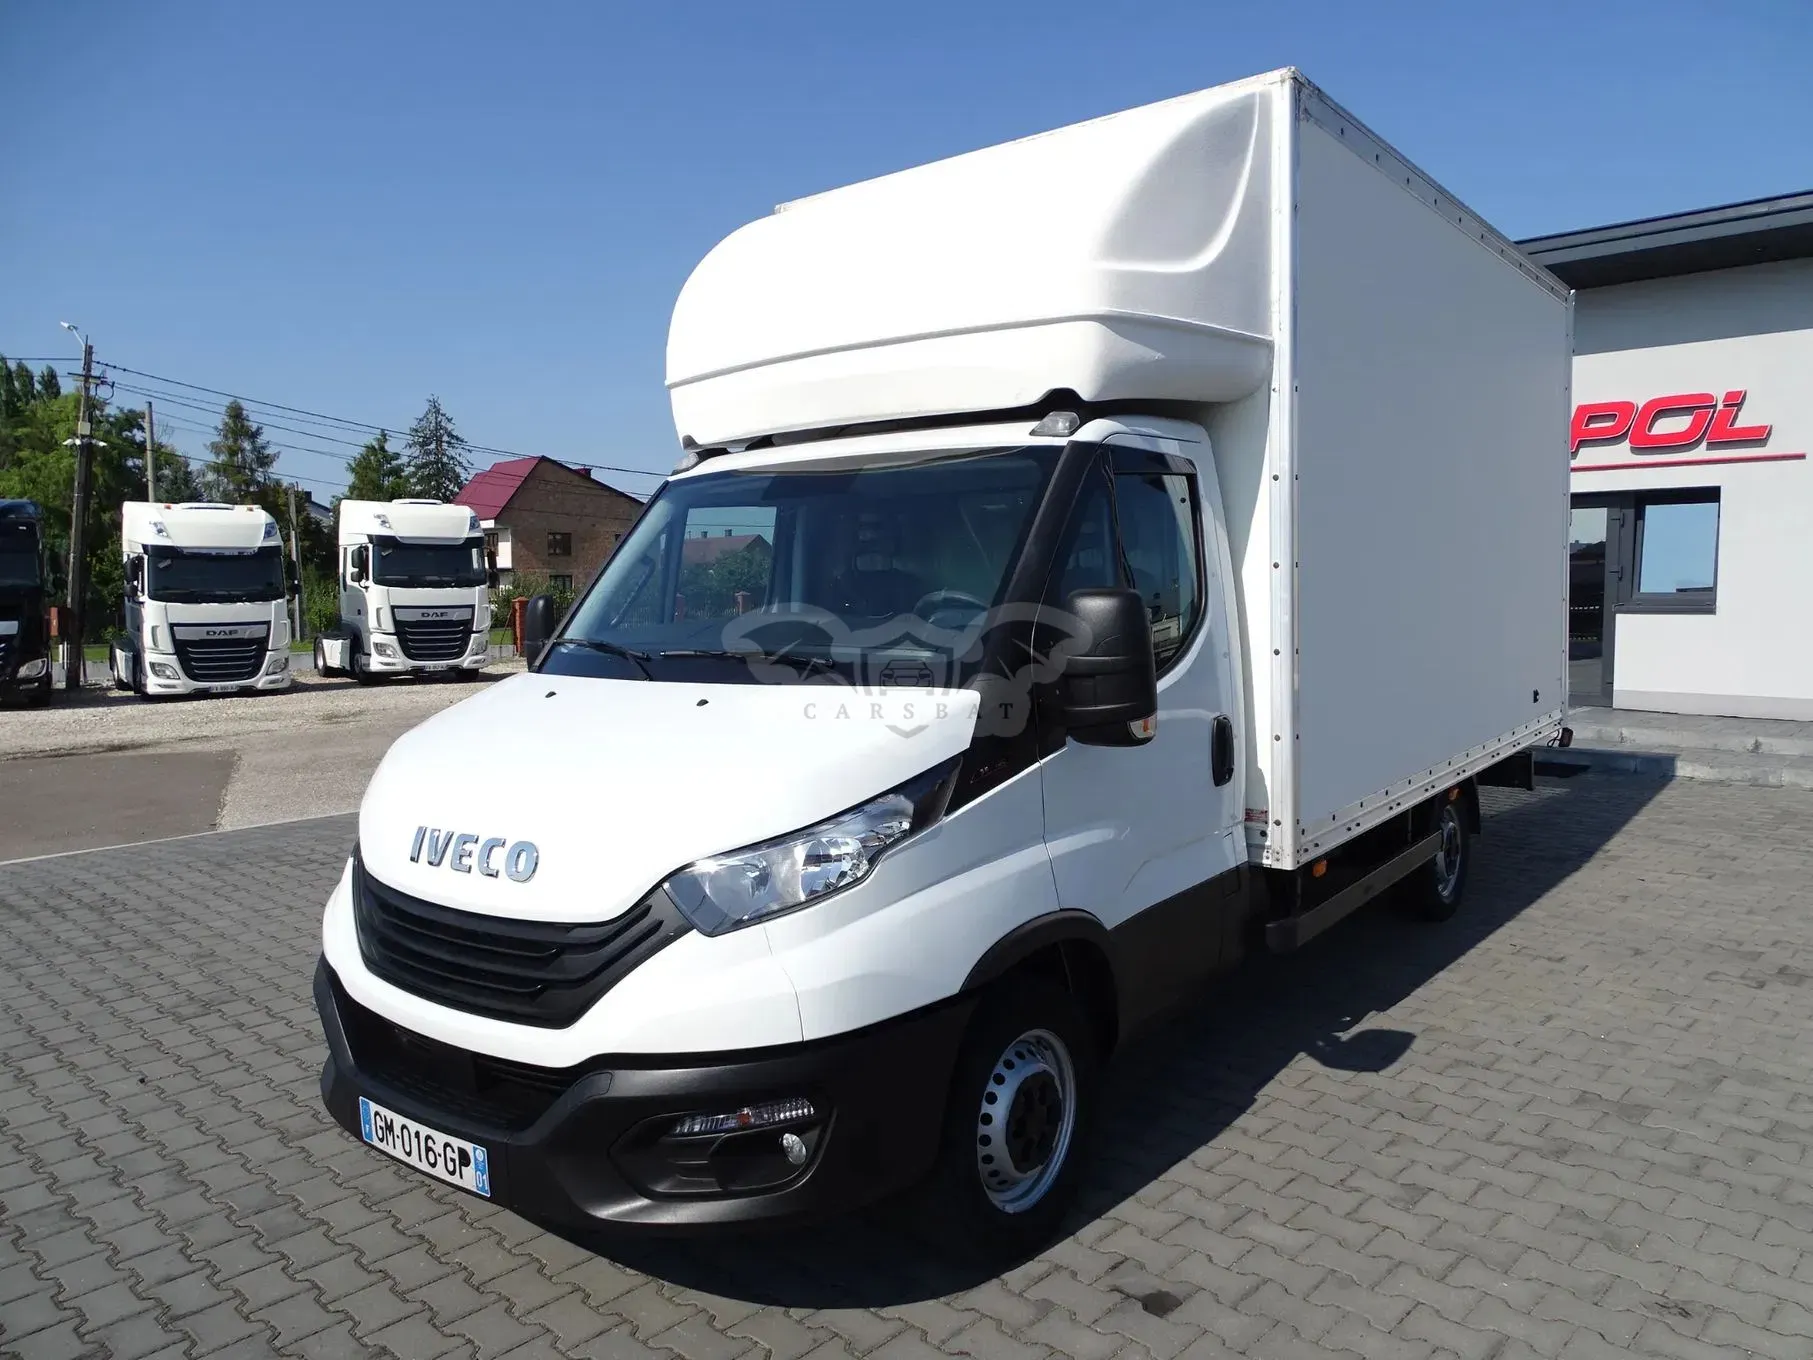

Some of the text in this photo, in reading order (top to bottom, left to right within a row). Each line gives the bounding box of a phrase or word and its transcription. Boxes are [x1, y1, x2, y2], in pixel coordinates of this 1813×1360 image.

[410, 826, 540, 883] IVECO
[373, 1110, 472, 1180] GM-016-GP
[476, 1170, 488, 1191] 01
